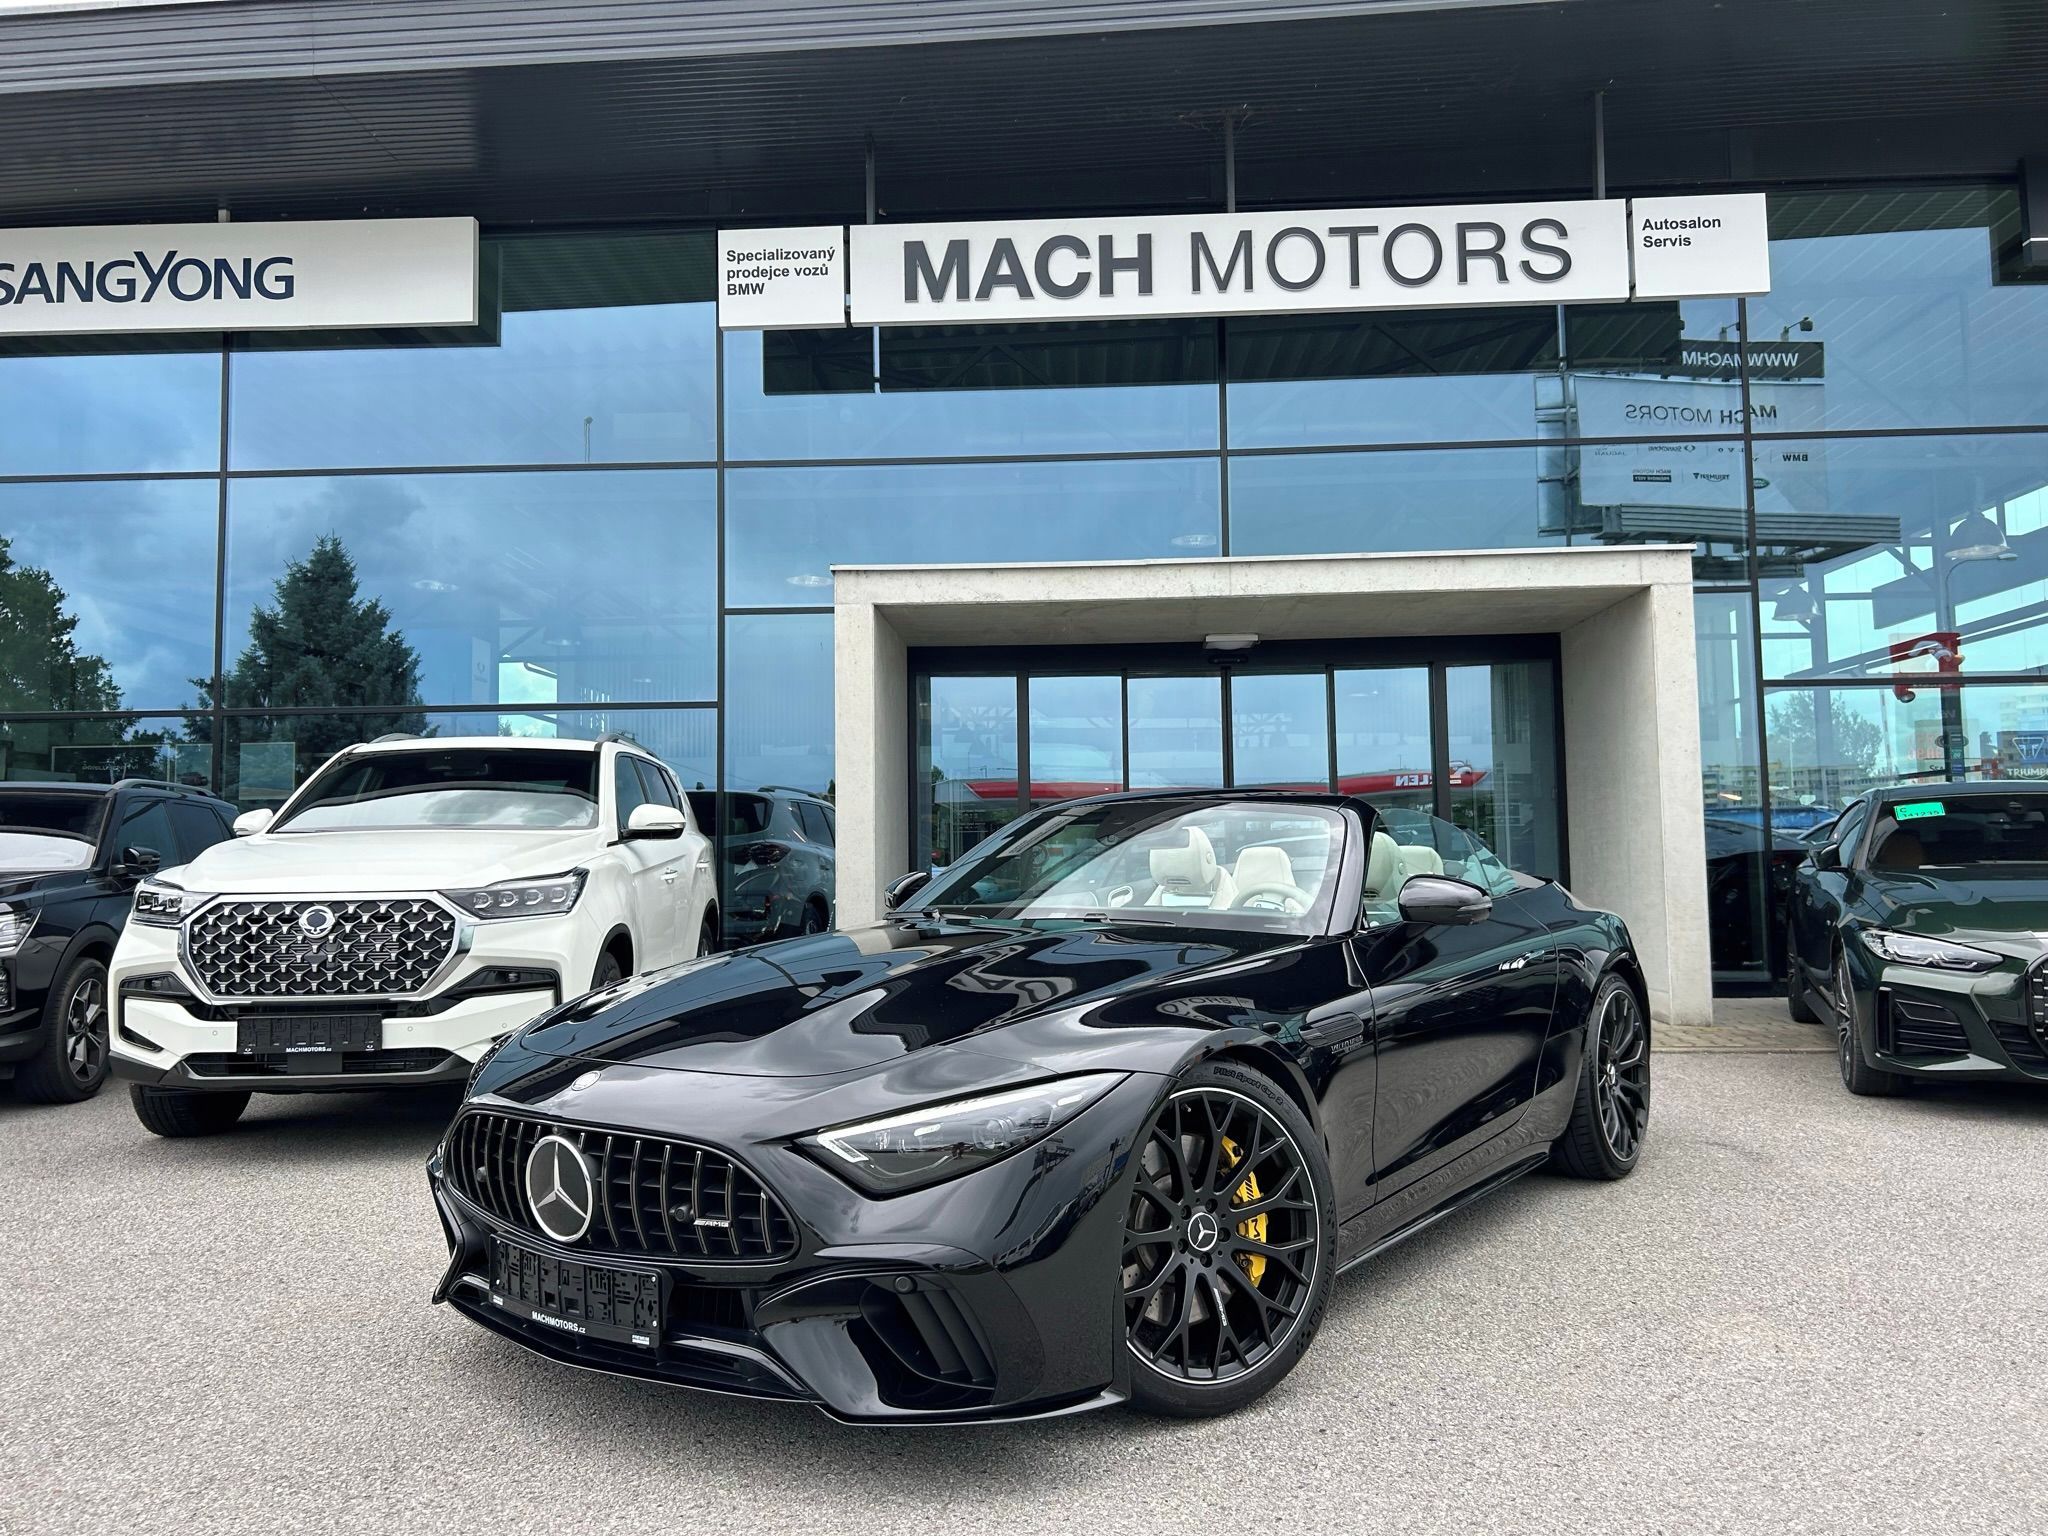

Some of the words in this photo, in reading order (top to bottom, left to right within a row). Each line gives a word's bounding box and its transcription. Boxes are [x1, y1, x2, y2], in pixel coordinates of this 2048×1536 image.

[1642, 216, 1721, 231] Autosalon
[1643, 234, 1692, 248] Servis
[726, 246, 836, 264] Specializovaný
[903, 233, 1153, 303] MACH
[1191, 218, 1572, 294] MOTORS
[727, 266, 790, 281] prodejce
[794, 263, 829, 277] vozů
[727, 282, 765, 296] BMW
[2007, 768, 2048, 778] TRIUMP
[1213, 1066, 1237, 1079] Pilot
[1236, 1072, 1262, 1090] Sport
[531, 1310, 586, 1334] MACHMOTORS.cz
